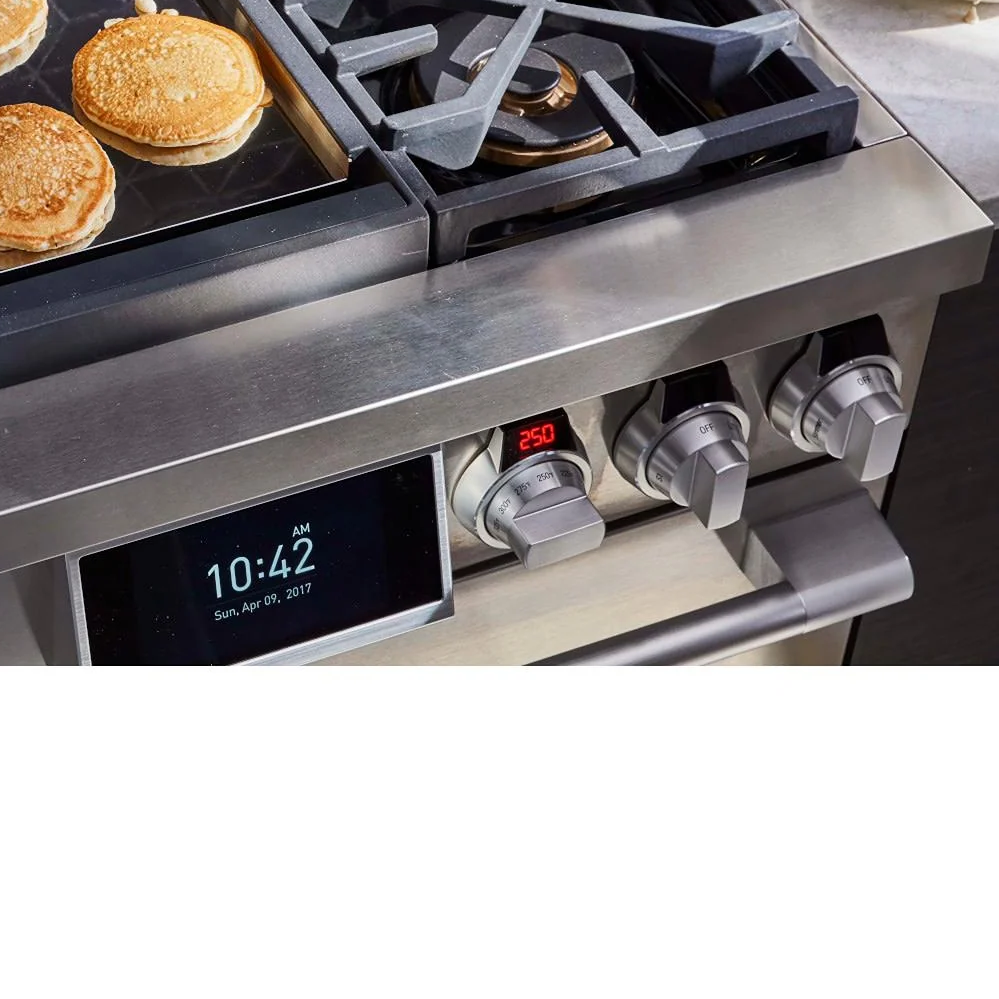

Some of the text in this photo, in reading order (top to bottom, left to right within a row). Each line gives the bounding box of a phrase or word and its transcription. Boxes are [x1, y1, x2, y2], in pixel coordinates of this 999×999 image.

[857, 375, 873, 387] OFF
[519, 423, 556, 450] 250
[699, 422, 715, 435] OFF
[292, 522, 311, 537] AM
[207, 537, 316, 599] 10:42
[214, 582, 312, 621] Sun, Apr 09, 2017
